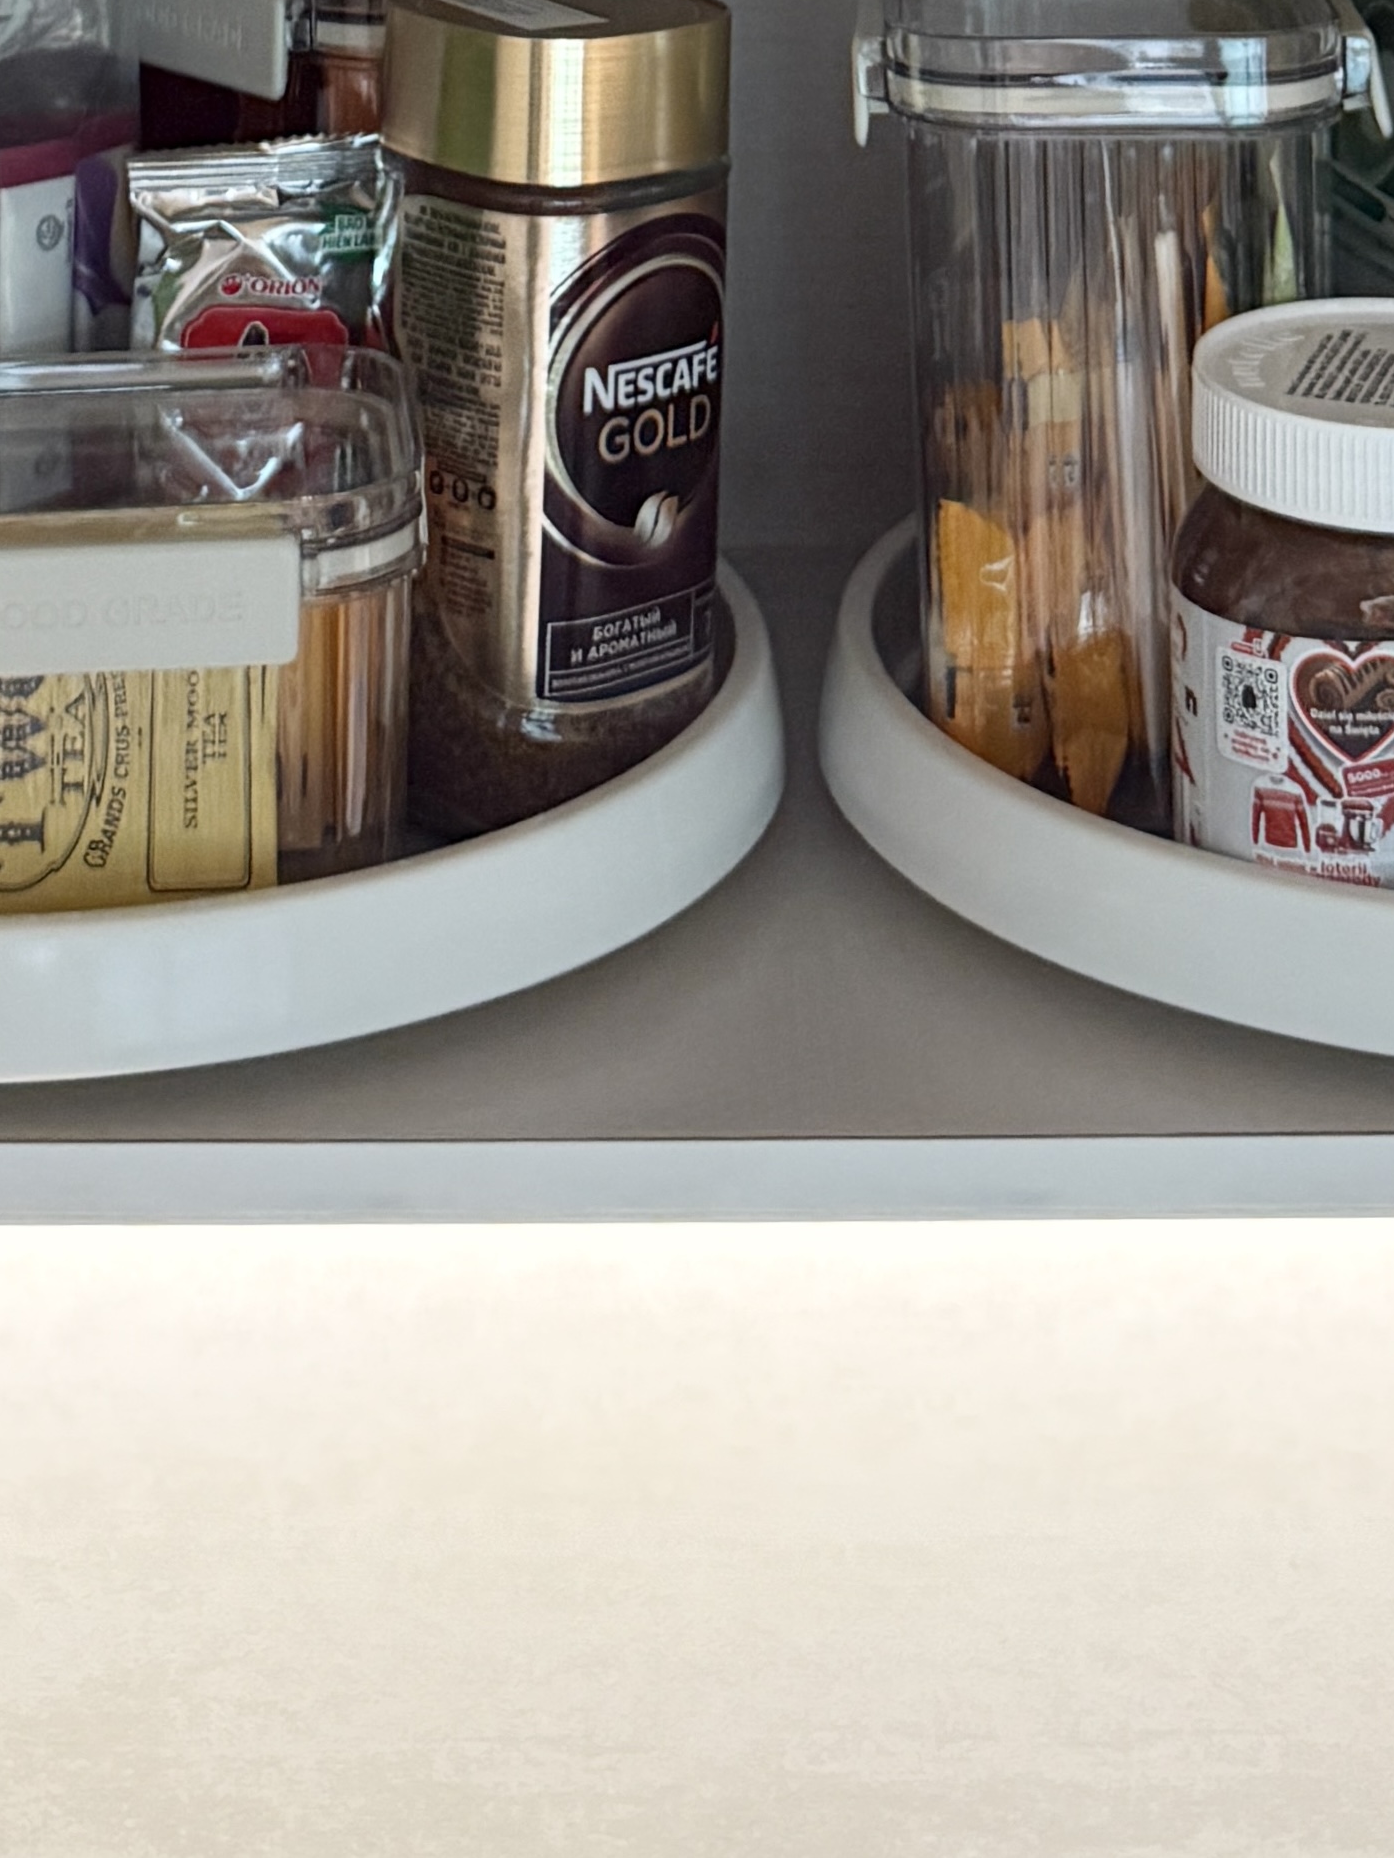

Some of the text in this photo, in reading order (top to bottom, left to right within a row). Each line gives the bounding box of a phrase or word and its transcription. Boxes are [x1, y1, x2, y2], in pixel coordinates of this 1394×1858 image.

[249, 276, 322, 296] ORION
[583, 323, 719, 417] NESCAFÉ
[598, 393, 712, 465] GOLD
[105, 592, 250, 628] GRADE
[591, 606, 662, 642] БОГАТЫЙ
[570, 644, 584, 665] И
[587, 620, 678, 661] АРОМАТНЫЙ
[62, 692, 86, 806] TEA
[184, 670, 200, 830] SILVER MOO
[201, 712, 217, 766] TEA
[83, 724, 129, 869] GRANDS CRUS
